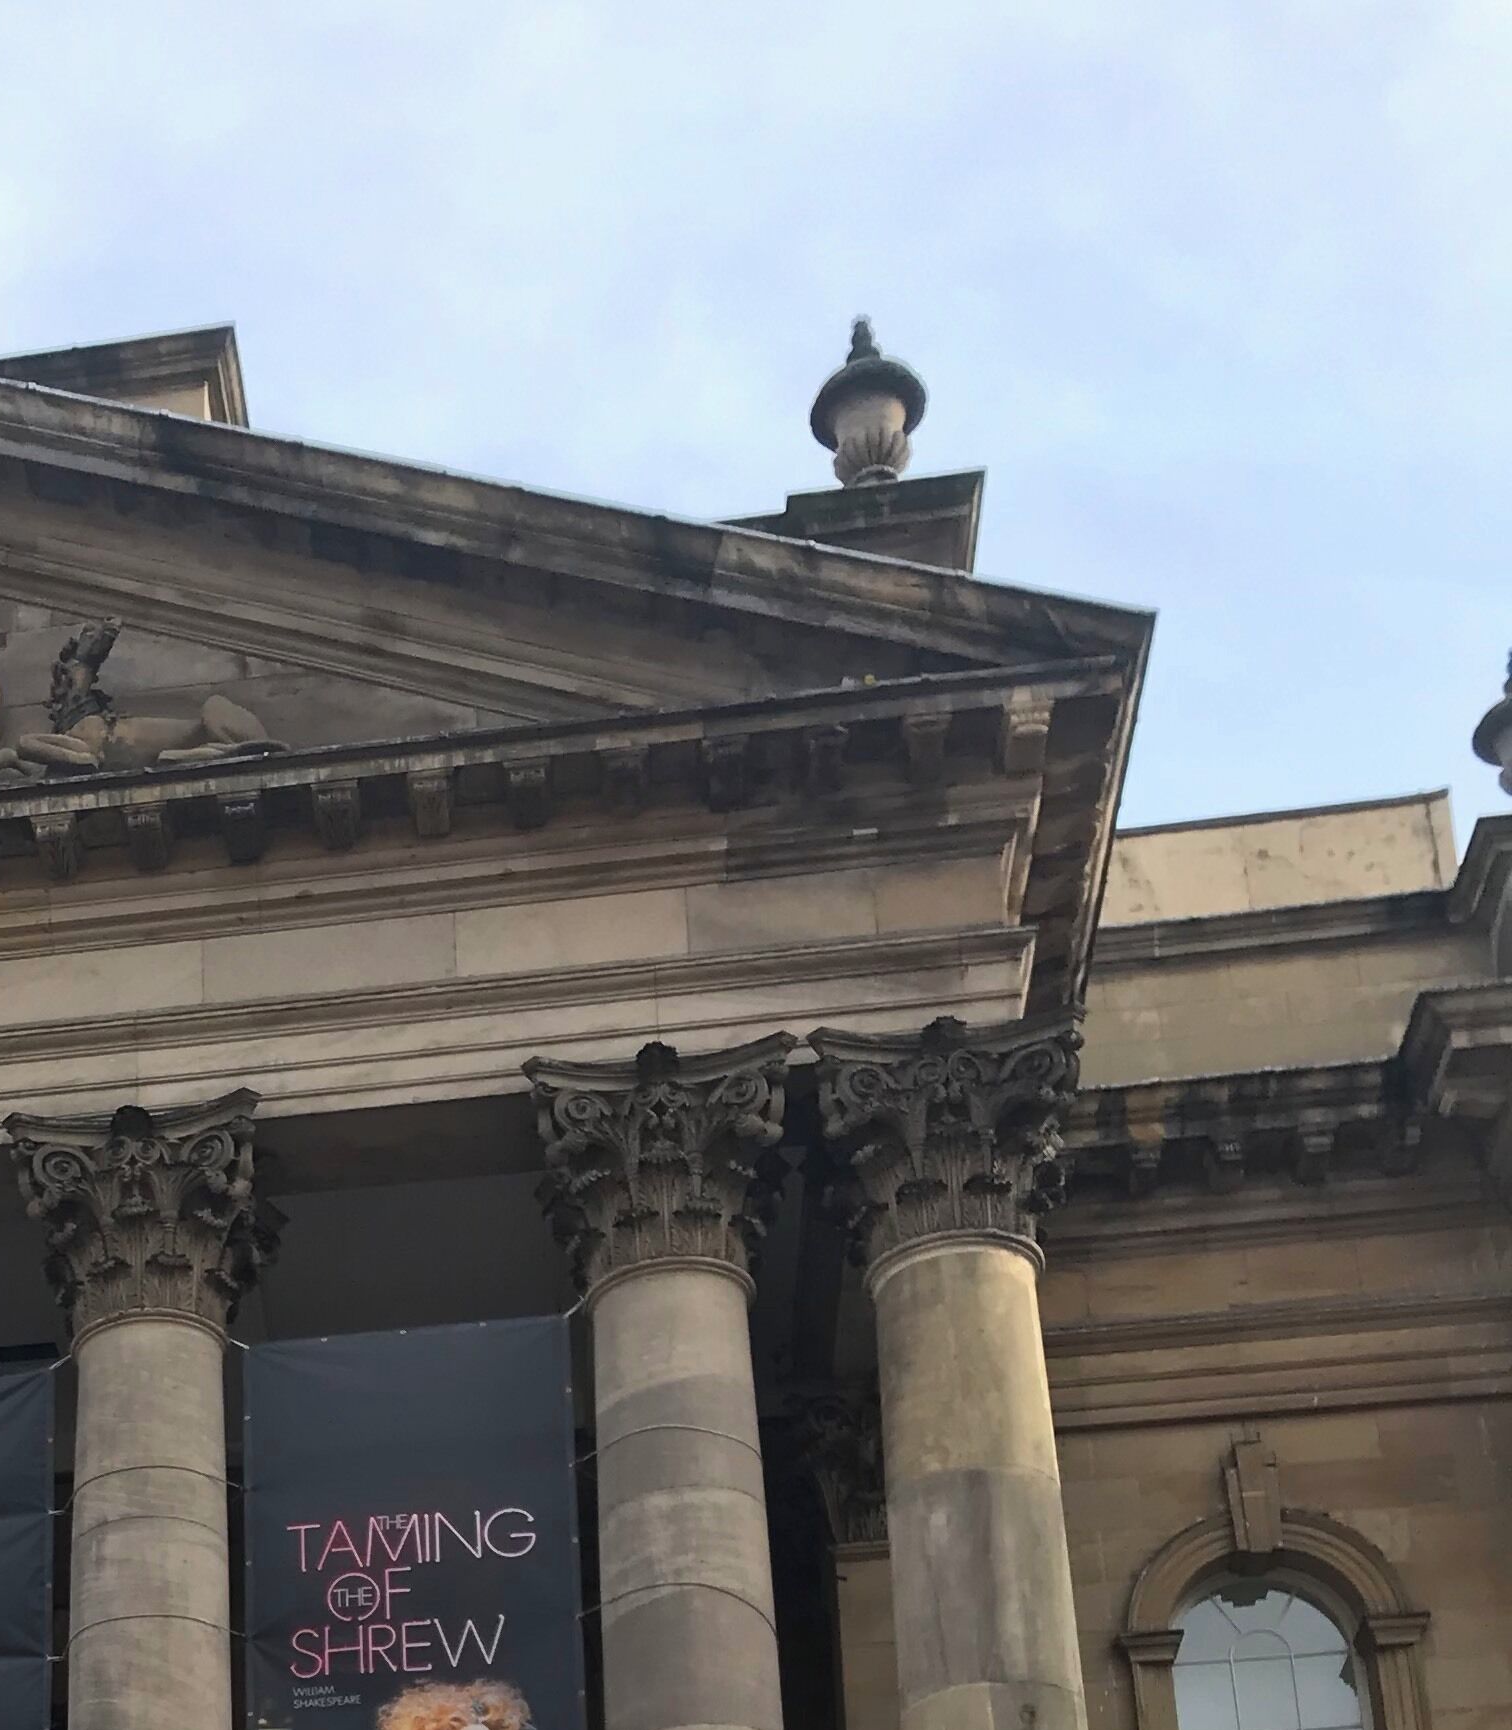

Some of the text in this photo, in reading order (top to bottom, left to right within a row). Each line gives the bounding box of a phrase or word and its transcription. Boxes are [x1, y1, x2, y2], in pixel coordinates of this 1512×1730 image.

[378, 1514, 409, 1530] THE
[287, 1507, 537, 1573] TAMING
[327, 1566, 412, 1621] OF
[333, 1586, 373, 1607] THE
[289, 1613, 506, 1679] SHREW
[292, 1684, 336, 1698] WILLIAM
[293, 1694, 362, 1710] SHAKESPEARE
